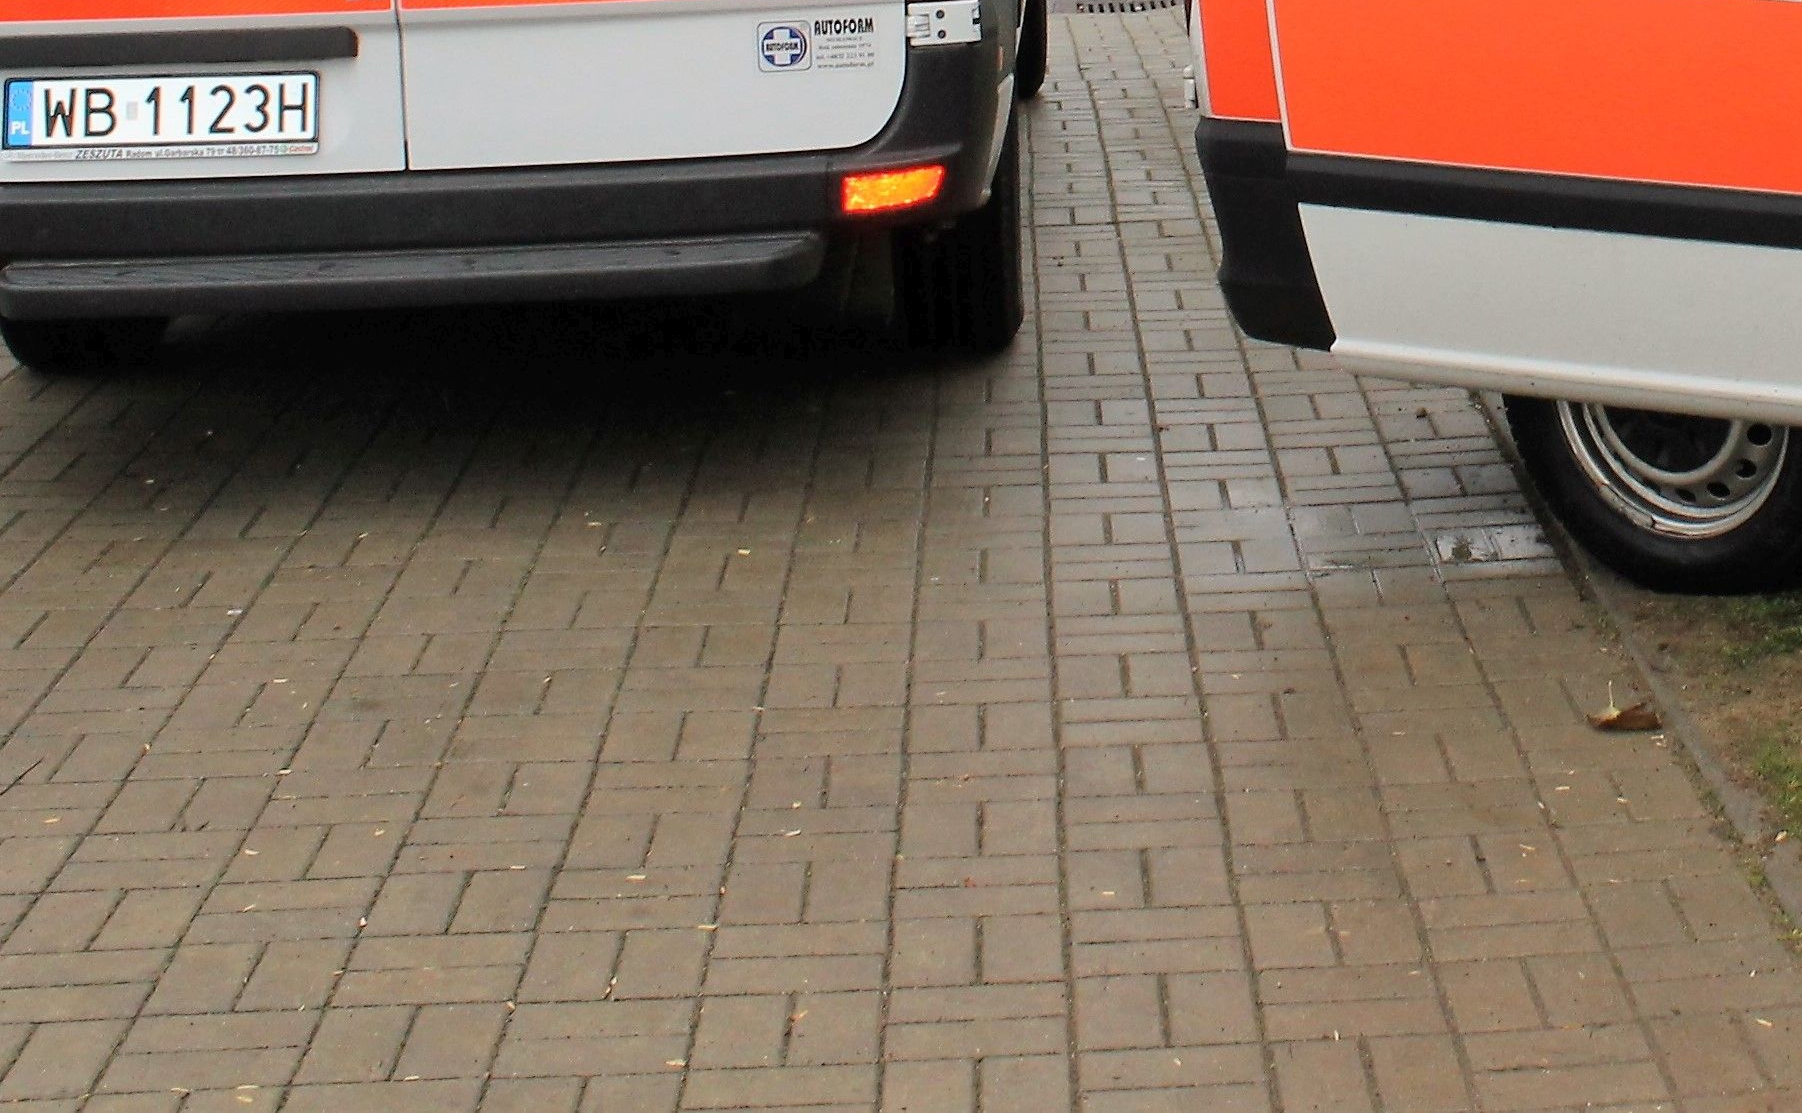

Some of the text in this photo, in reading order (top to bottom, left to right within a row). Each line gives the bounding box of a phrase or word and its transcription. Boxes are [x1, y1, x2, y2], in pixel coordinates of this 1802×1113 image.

[814, 17, 875, 36] AUTOFORM
[44, 81, 309, 138] WB 1123H
[10, 122, 30, 135] PL
[75, 149, 123, 160] ZESZUTA
